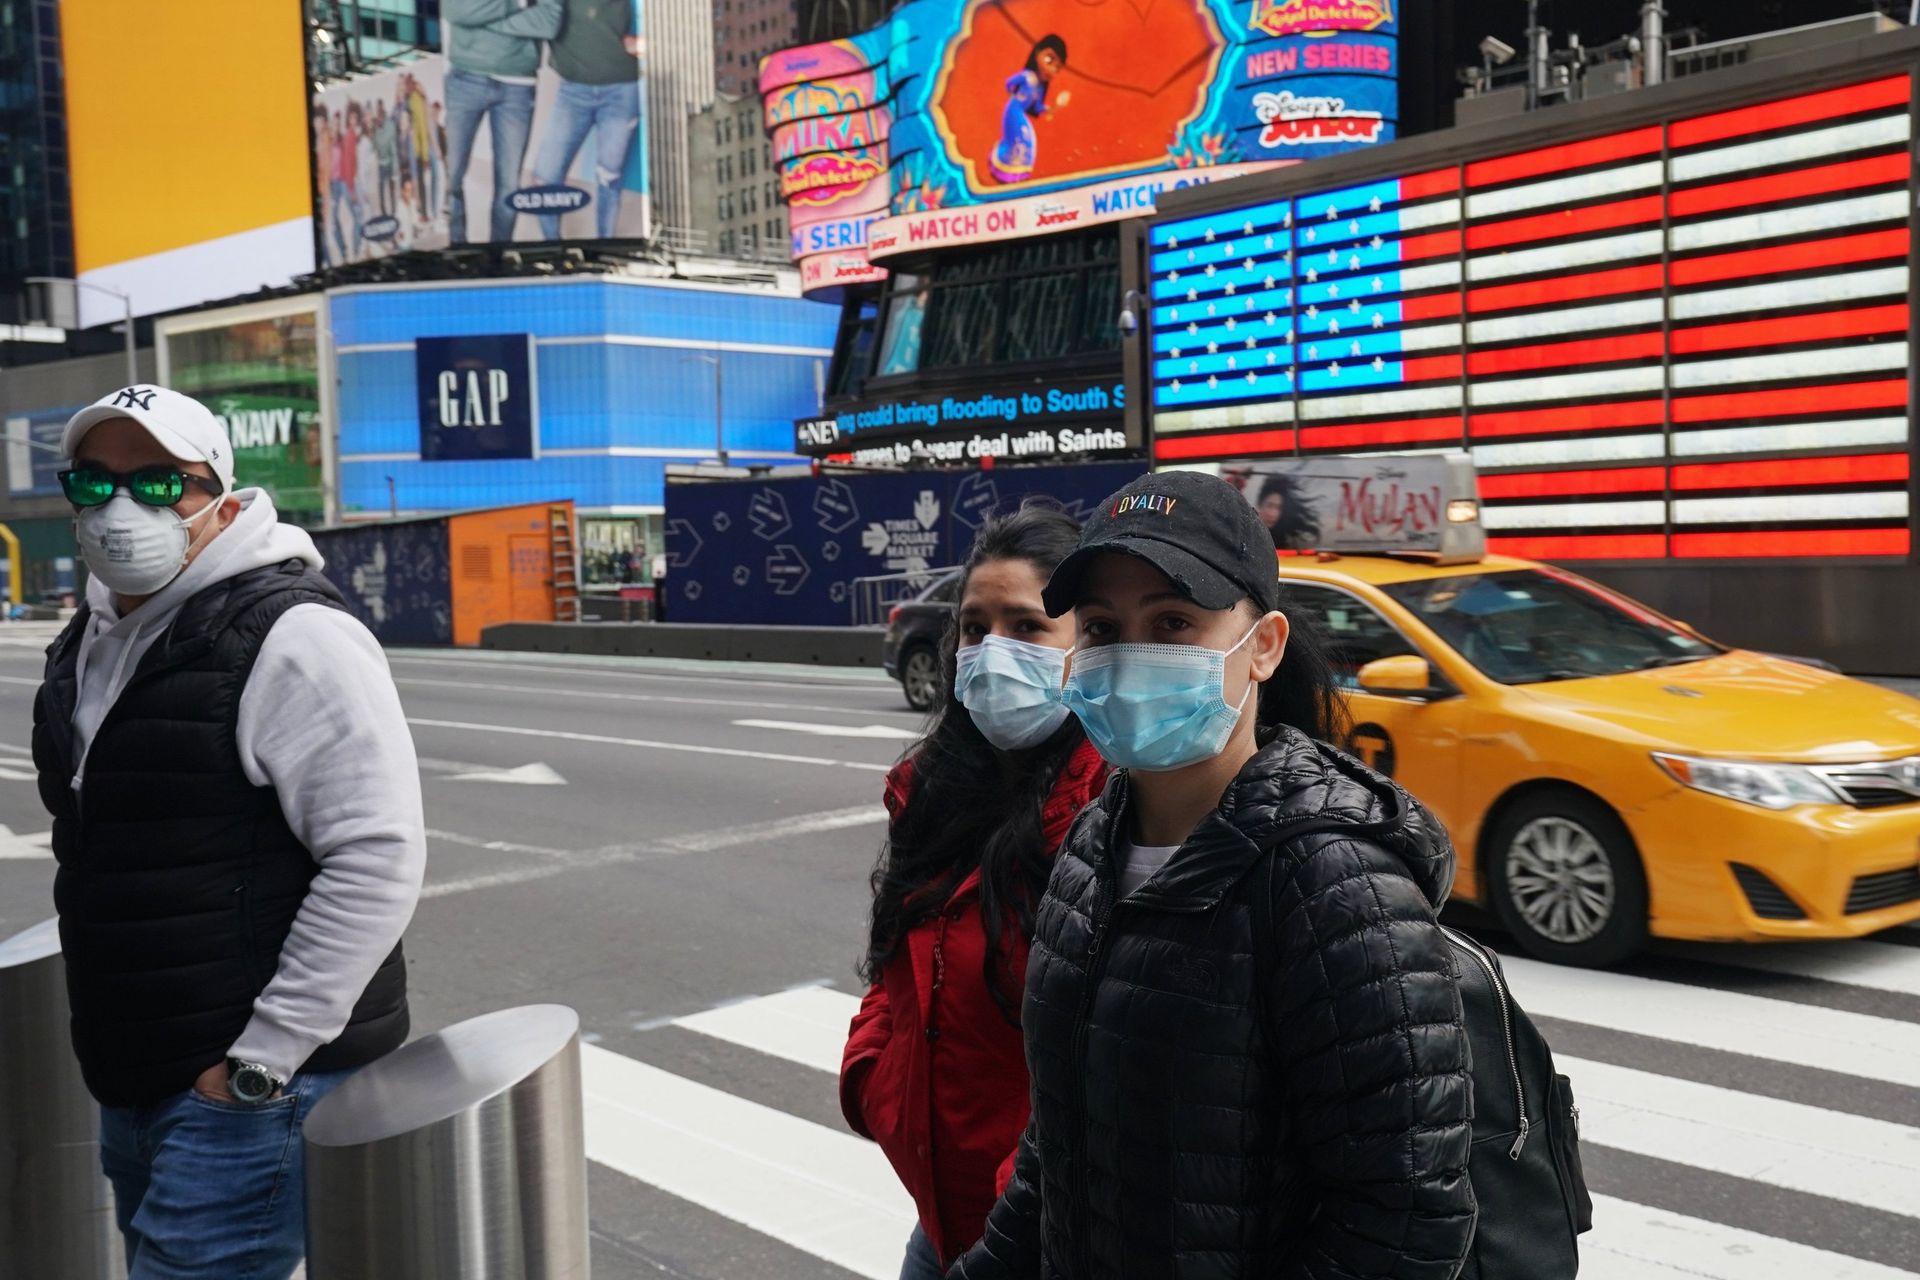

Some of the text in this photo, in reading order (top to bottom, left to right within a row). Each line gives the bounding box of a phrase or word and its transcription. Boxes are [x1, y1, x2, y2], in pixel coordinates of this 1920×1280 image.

[1247, 43, 1390, 79] NEW SERIES
[811, 218, 880, 250] SERI
[908, 209, 1016, 242] WATCH ON
[438, 368, 509, 428] GAP
[857, 404, 894, 428] could
[895, 402, 938, 426] bring
[942, 394, 1017, 421] flooding
[1021, 392, 1042, 414] to
[1046, 386, 1109, 412] South
[230, 407, 293, 449] NAVY
[967, 433, 1008, 458] deal
[1011, 430, 1055, 455] with
[1058, 428, 1126, 453] Saints
[1336, 477, 1441, 534] MULAN
[891, 532, 938, 545] SQUARE
